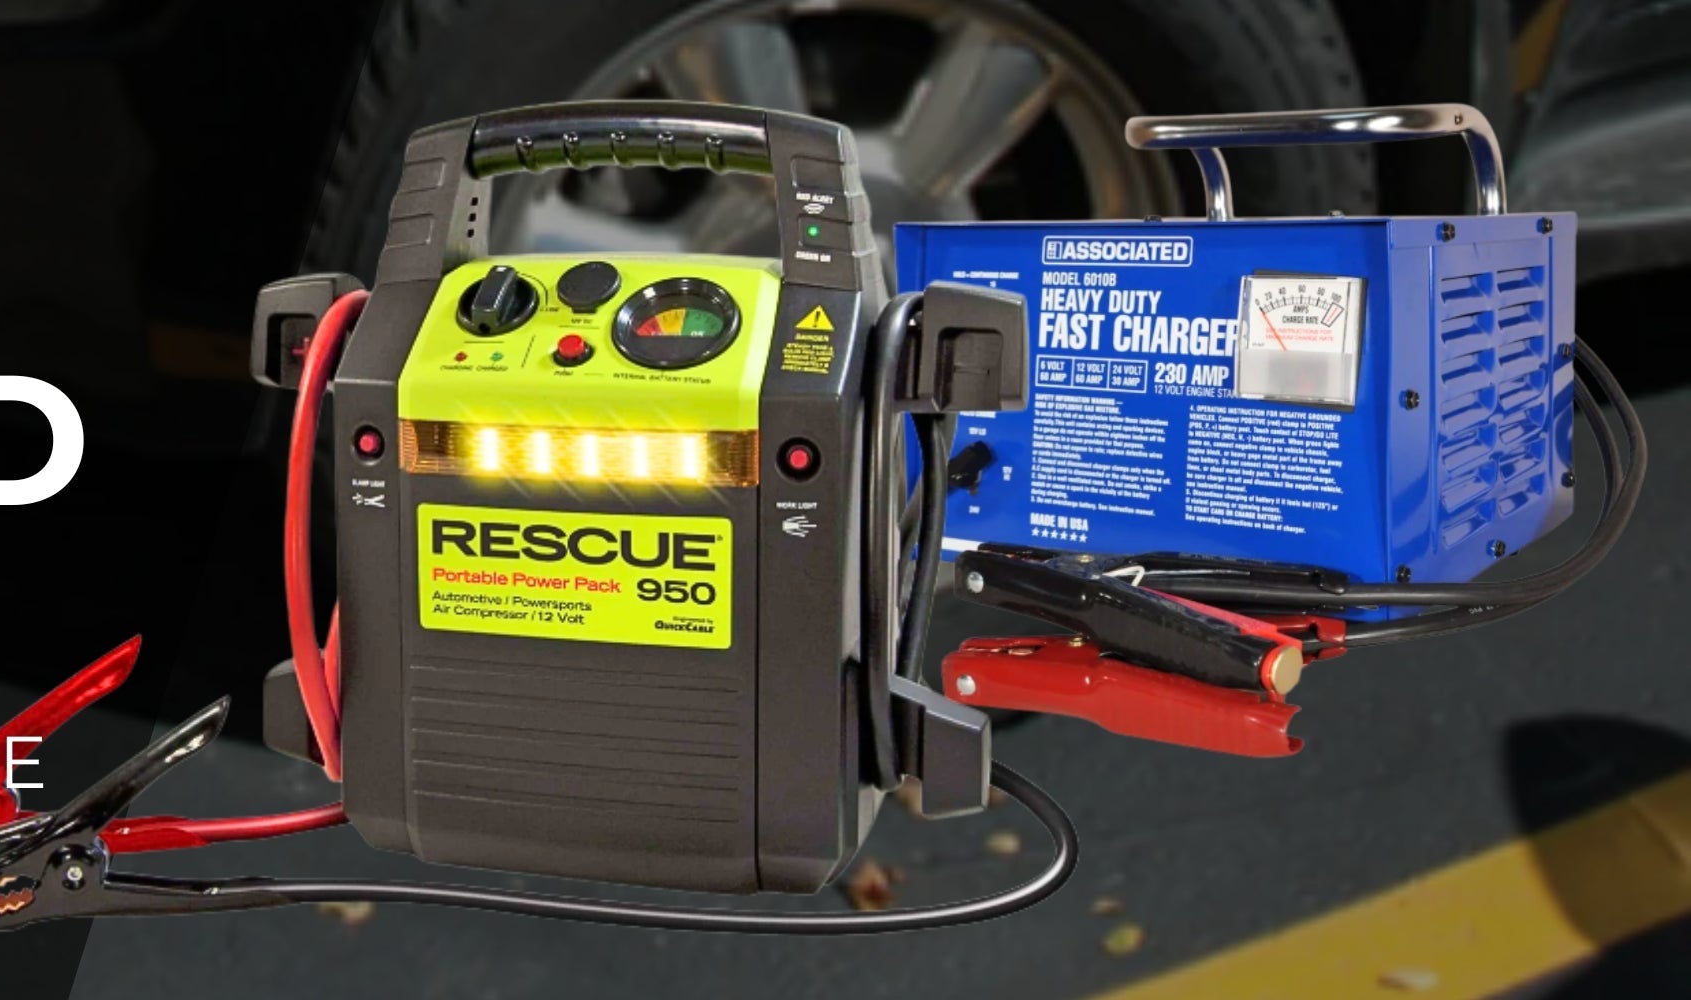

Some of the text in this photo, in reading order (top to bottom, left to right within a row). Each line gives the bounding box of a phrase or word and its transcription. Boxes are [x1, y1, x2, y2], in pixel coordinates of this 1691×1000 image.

[1063, 242, 1188, 261] ASSOCIATED
[1042, 272, 1116, 286] MODEL 6010B
[1041, 288, 1162, 314] HEAVY DUTY
[1293, 305, 1309, 314] AMPS
[1282, 316, 1318, 325] CHARGE RATE
[1038, 312, 1106, 350] FAST
[1047, 361, 1065, 371] VOLT
[1076, 362, 1106, 373] 12 VOLT
[1112, 365, 1142, 375] 24 VOLT
[1051, 373, 1067, 382] AMP
[1086, 374, 1103, 384] AMP
[1123, 377, 1140, 386] AMP
[1154, 363, 1229, 387] 230 AMP
[1154, 385, 1163, 394] 12
[1165, 385, 1185, 395] VOLT
[1186, 386, 1215, 397] ENGINE
[1030, 512, 1088, 532] MADE IN USA
[432, 519, 716, 572] RESCUE
[433, 567, 621, 594] Portable Power Pack
[636, 578, 716, 606] 950
[432, 591, 502, 605] Automotive
[512, 597, 592, 611] Powersports
[433, 604, 450, 613] Air
[454, 605, 528, 620] Compressor
[557, 613, 584, 624] Volt
